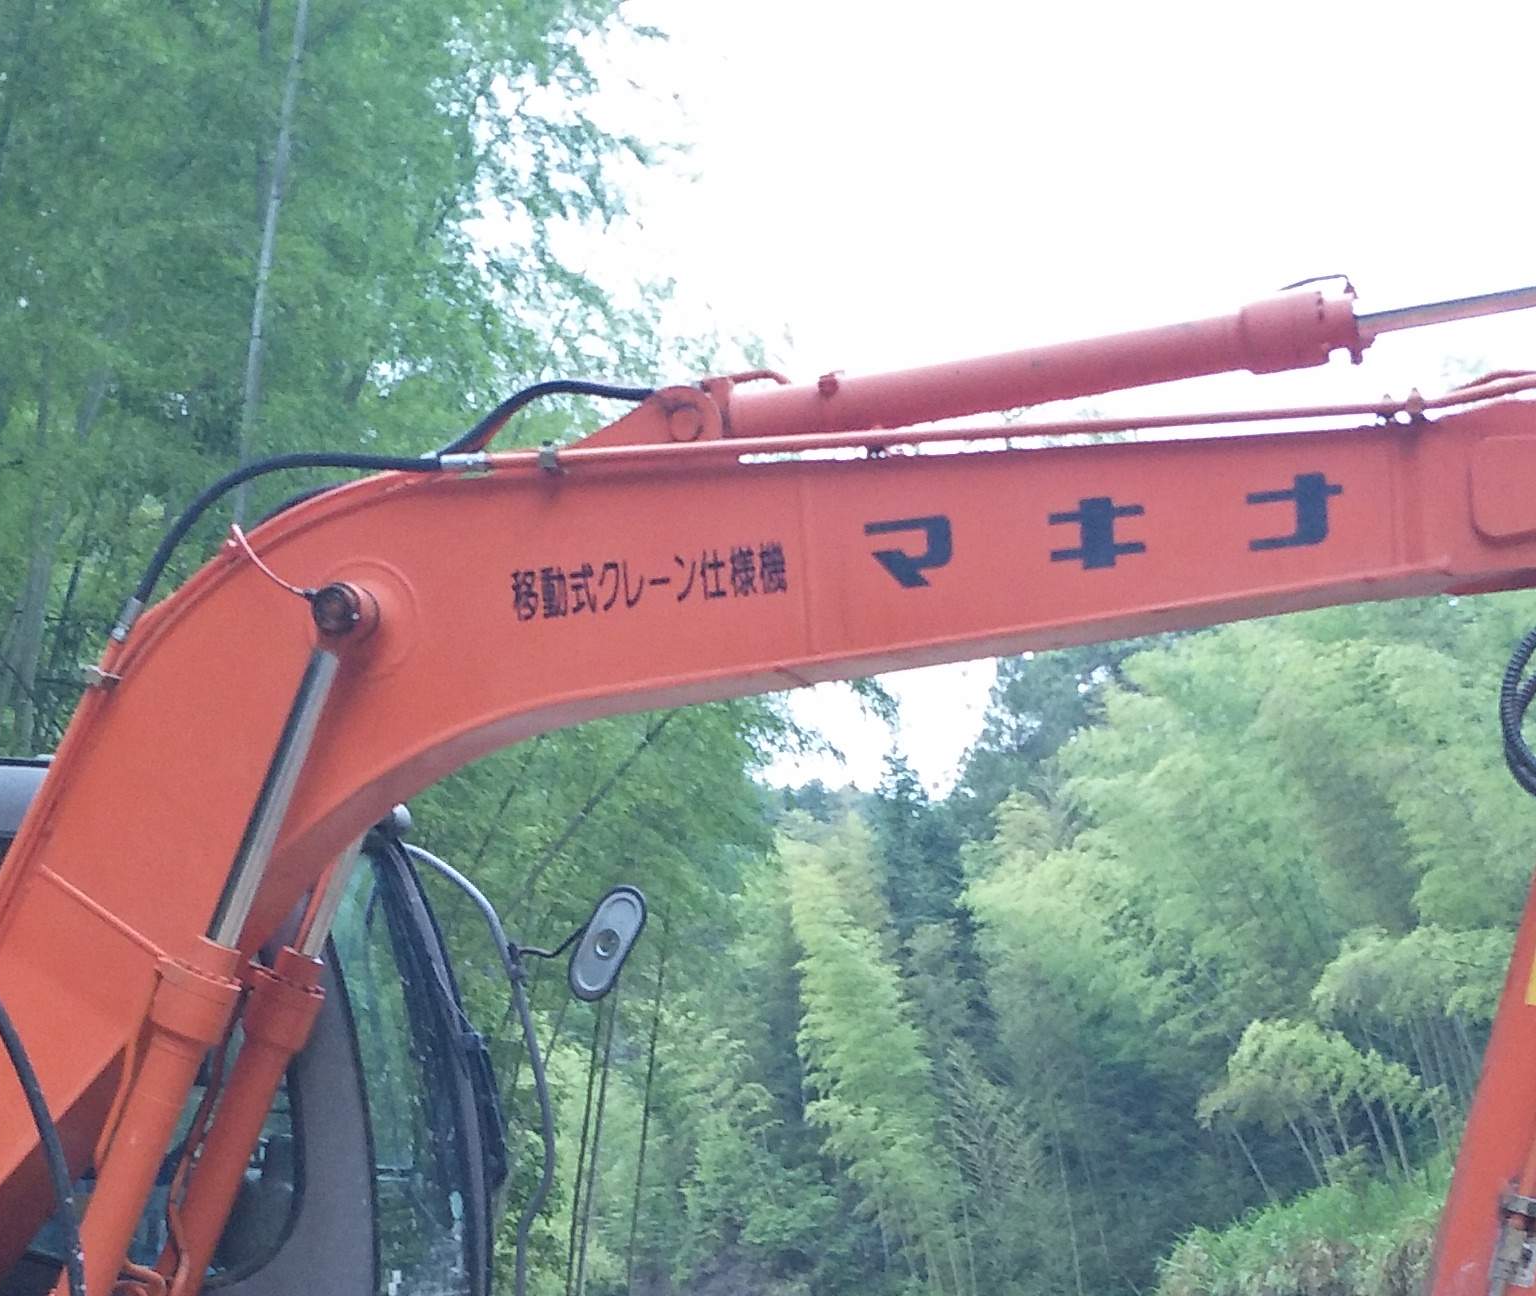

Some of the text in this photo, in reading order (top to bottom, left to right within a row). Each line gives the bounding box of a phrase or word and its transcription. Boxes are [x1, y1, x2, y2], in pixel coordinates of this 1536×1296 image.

[863, 470, 1344, 590] マキナ
[510, 540, 788, 622] 移動式クレーン仕様機
